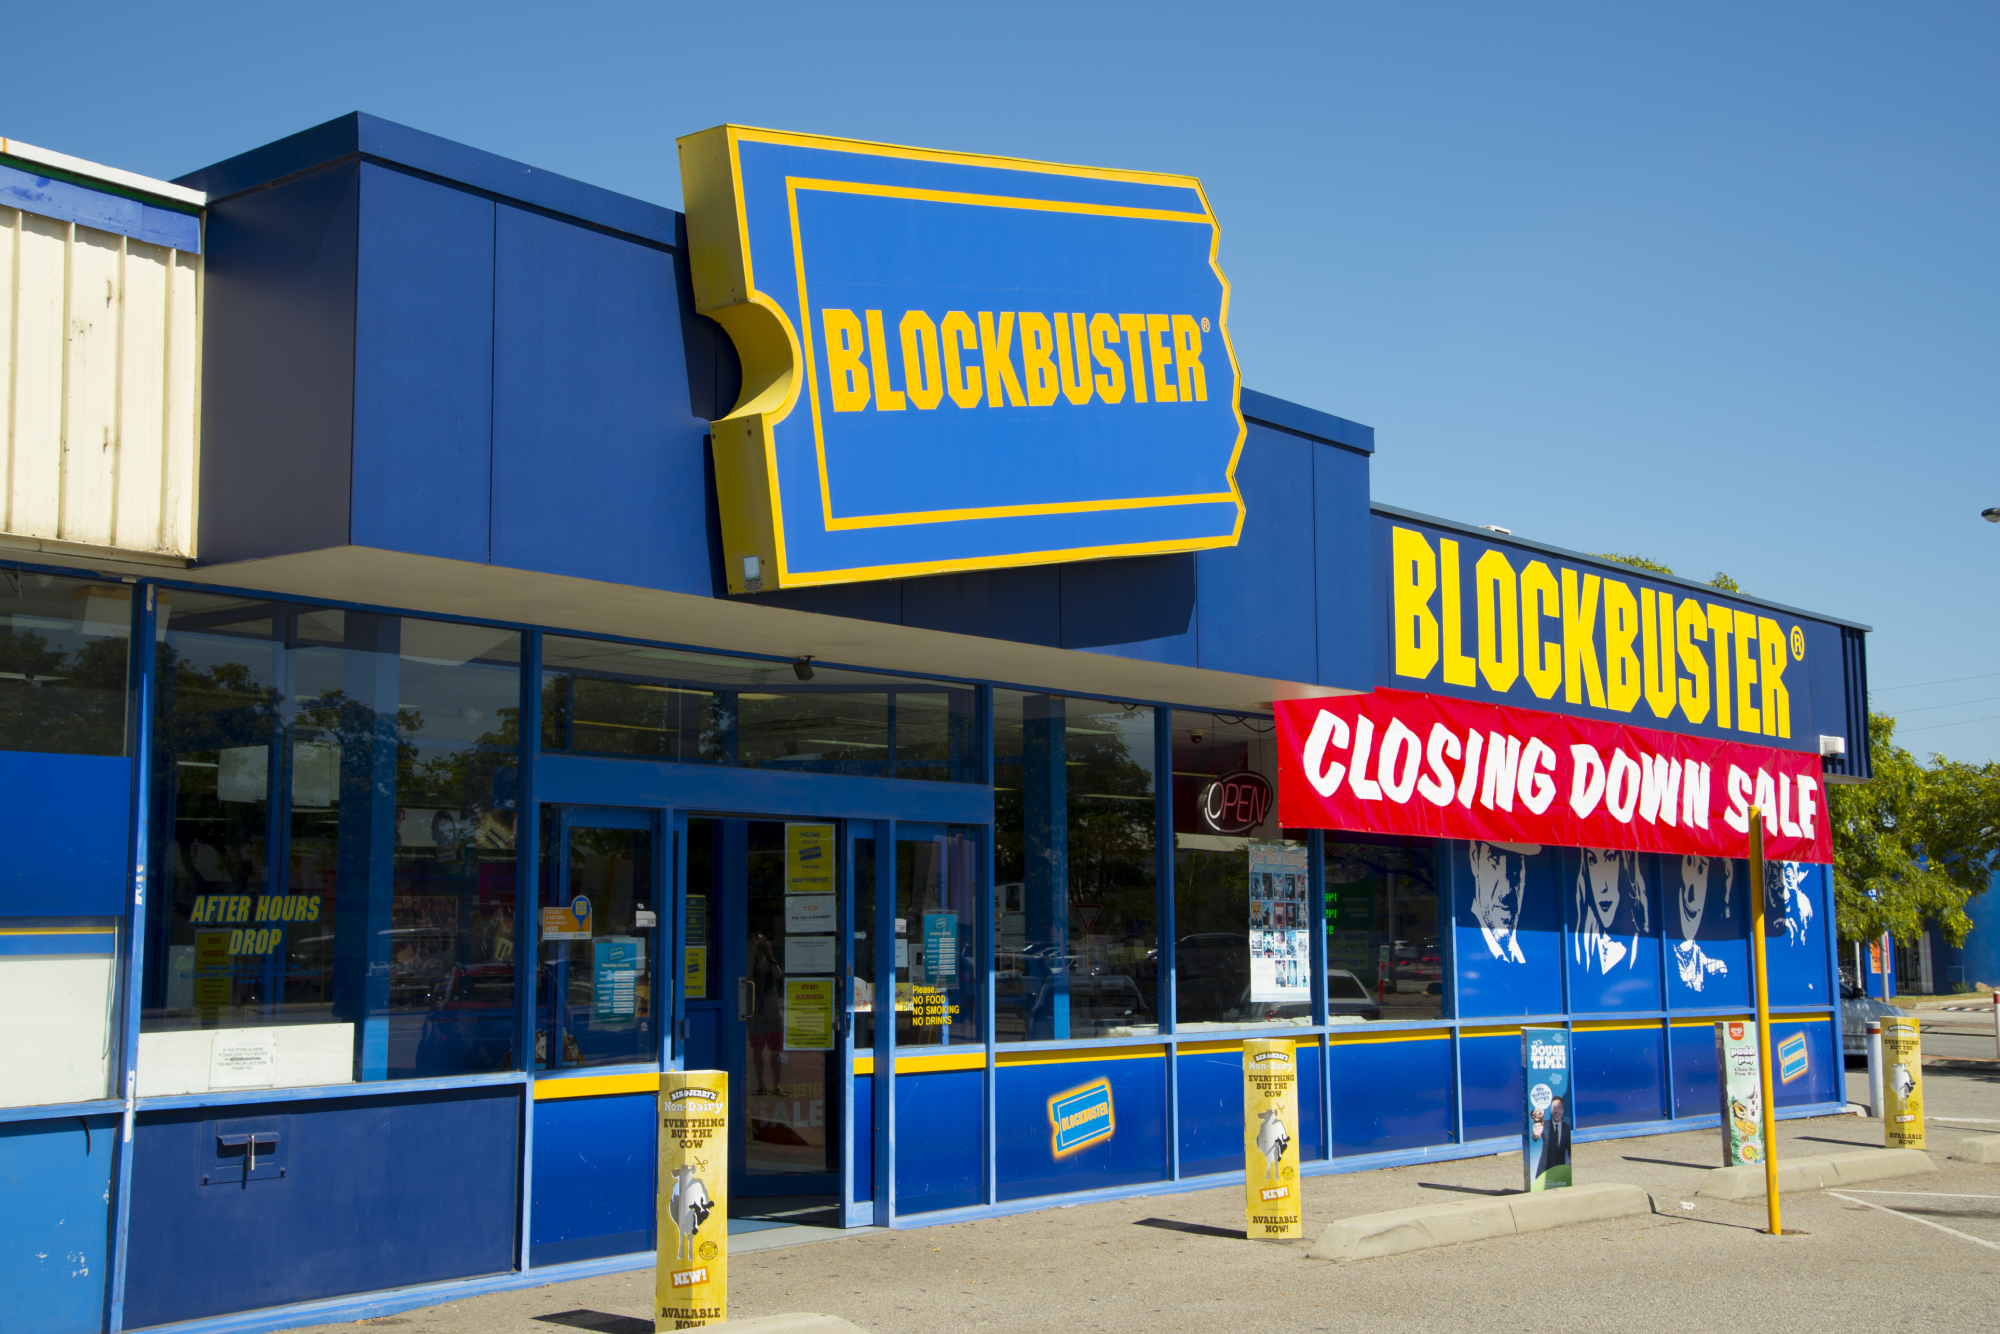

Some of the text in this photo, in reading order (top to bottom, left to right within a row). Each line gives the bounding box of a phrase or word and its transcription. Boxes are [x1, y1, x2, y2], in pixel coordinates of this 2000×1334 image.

[1303, 709, 1817, 840] CLOSING DOWN SALE
[1207, 781, 1267, 823] OPEN
[188, 894, 321, 924] AFTER HOURS
[226, 928, 283, 957] DROP
[913, 995, 946, 1004] NO FOOD
[913, 1007, 923, 1015] NO
[926, 1005, 959, 1015] SMOKING
[913, 1016, 952, 1026] NO DRINKS
[1885, 1031, 1917, 1039] Non-Dairy
[1531, 1045, 1565, 1056] DOUGH
[1248, 1061, 1293, 1072] Non-Dairy
[1531, 1056, 1566, 1069] TIME!
[1248, 1074, 1295, 1082] EVERYTHING
[1264, 1090, 1282, 1098] COW
[664, 1101, 723, 1115] Non-Dairy
[1061, 1101, 1108, 1132] BLOCKBUSTER
[1895, 1114, 1915, 1122] NEW!
[663, 1118, 725, 1128] EVERYTHING
[671, 1129, 713, 1139] BUT THE
[680, 1139, 704, 1149] COW
[1262, 1186, 1289, 1200] NEW!
[1252, 1216, 1298, 1224] AVAILABLE
[1265, 1225, 1289, 1233] NOW!
[673, 1268, 707, 1286] NEW!
[661, 1307, 721, 1319] AVAILABLE
